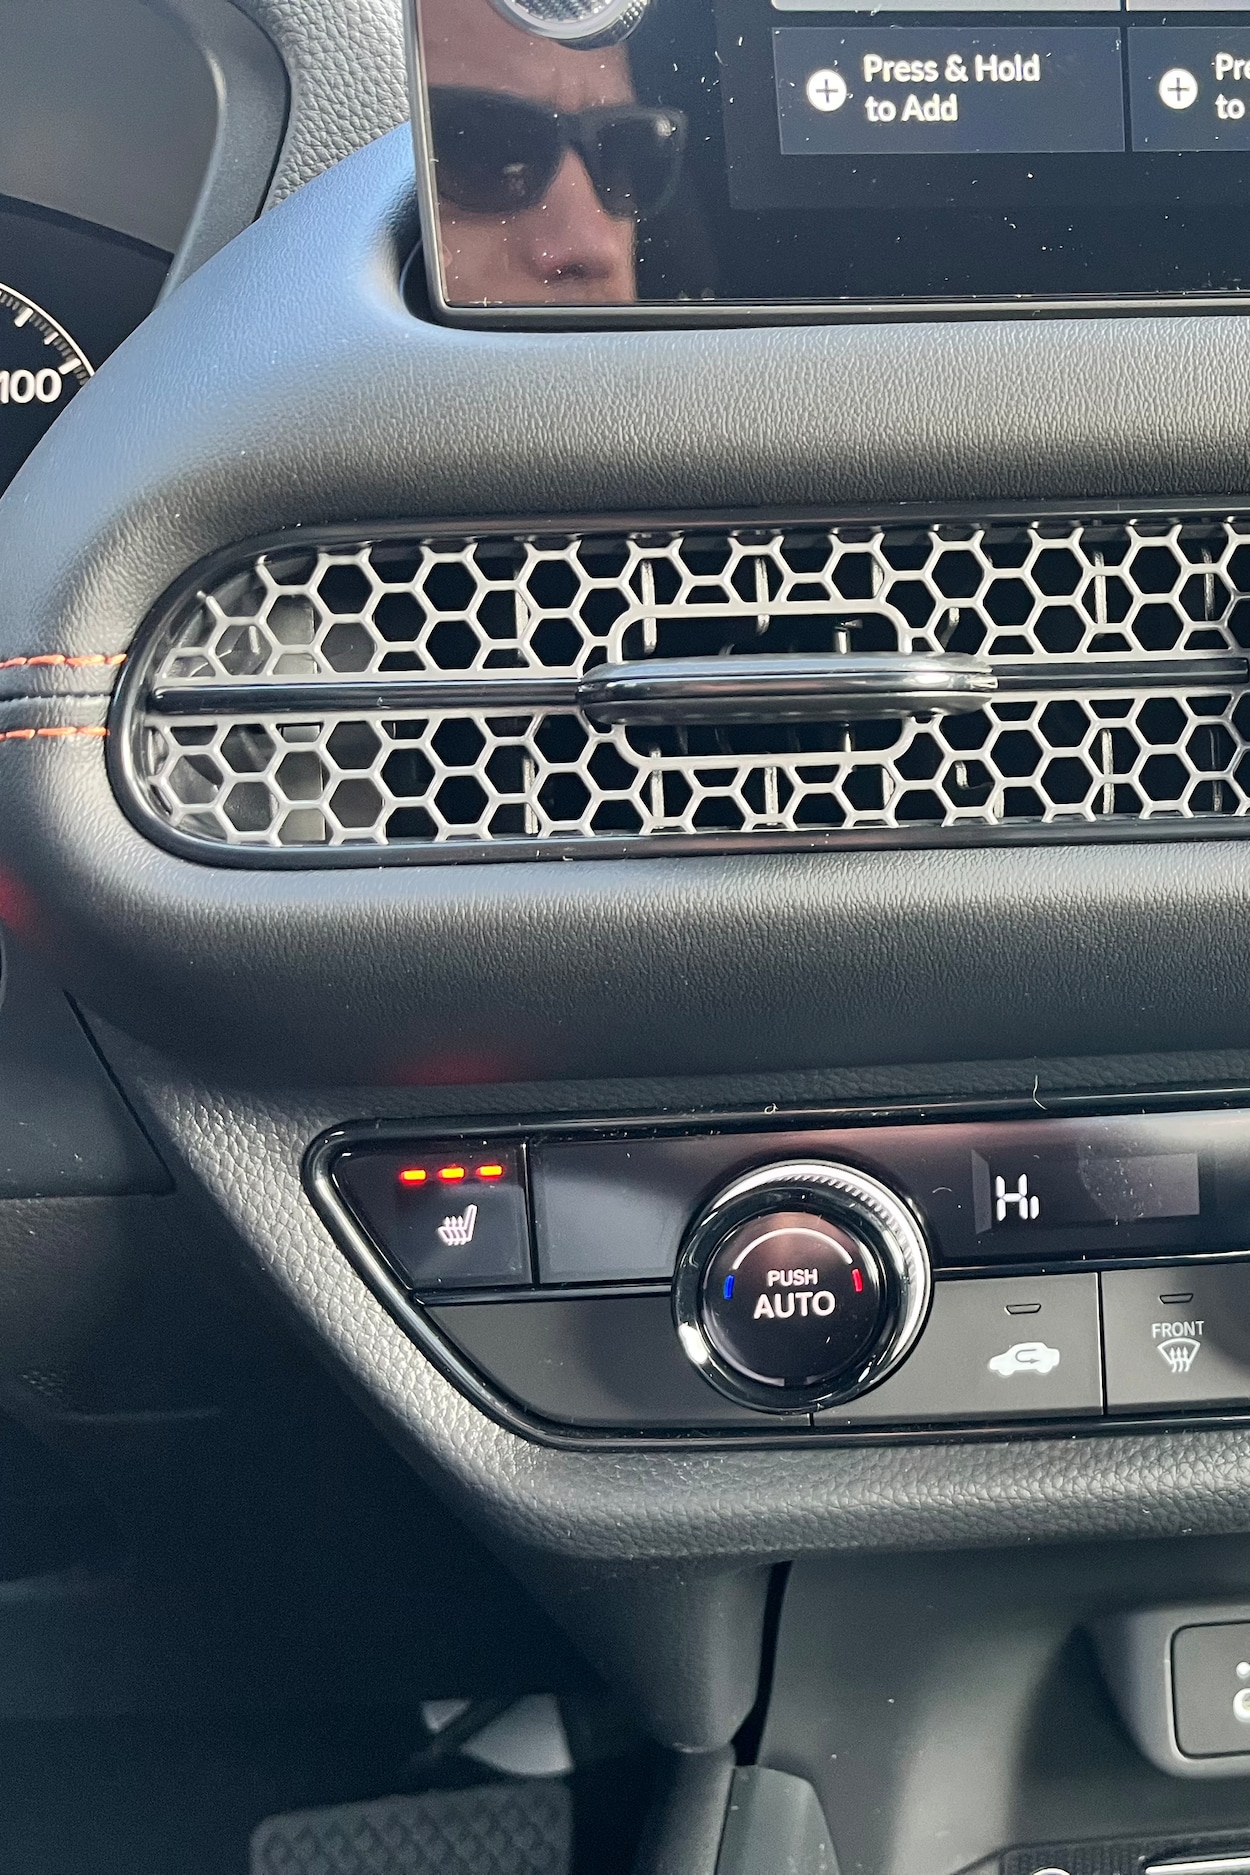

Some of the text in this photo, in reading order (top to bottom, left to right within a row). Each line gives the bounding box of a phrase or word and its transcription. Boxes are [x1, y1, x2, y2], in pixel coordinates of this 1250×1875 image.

[862, 54, 1041, 83] Press & Hold
[864, 94, 958, 122] to Add
[1215, 95, 1246, 119] to
[0, 369, 62, 404] 100
[766, 1268, 819, 1287] PUSH
[753, 1291, 836, 1320] AUTO
[1151, 1320, 1204, 1338] FRONT
